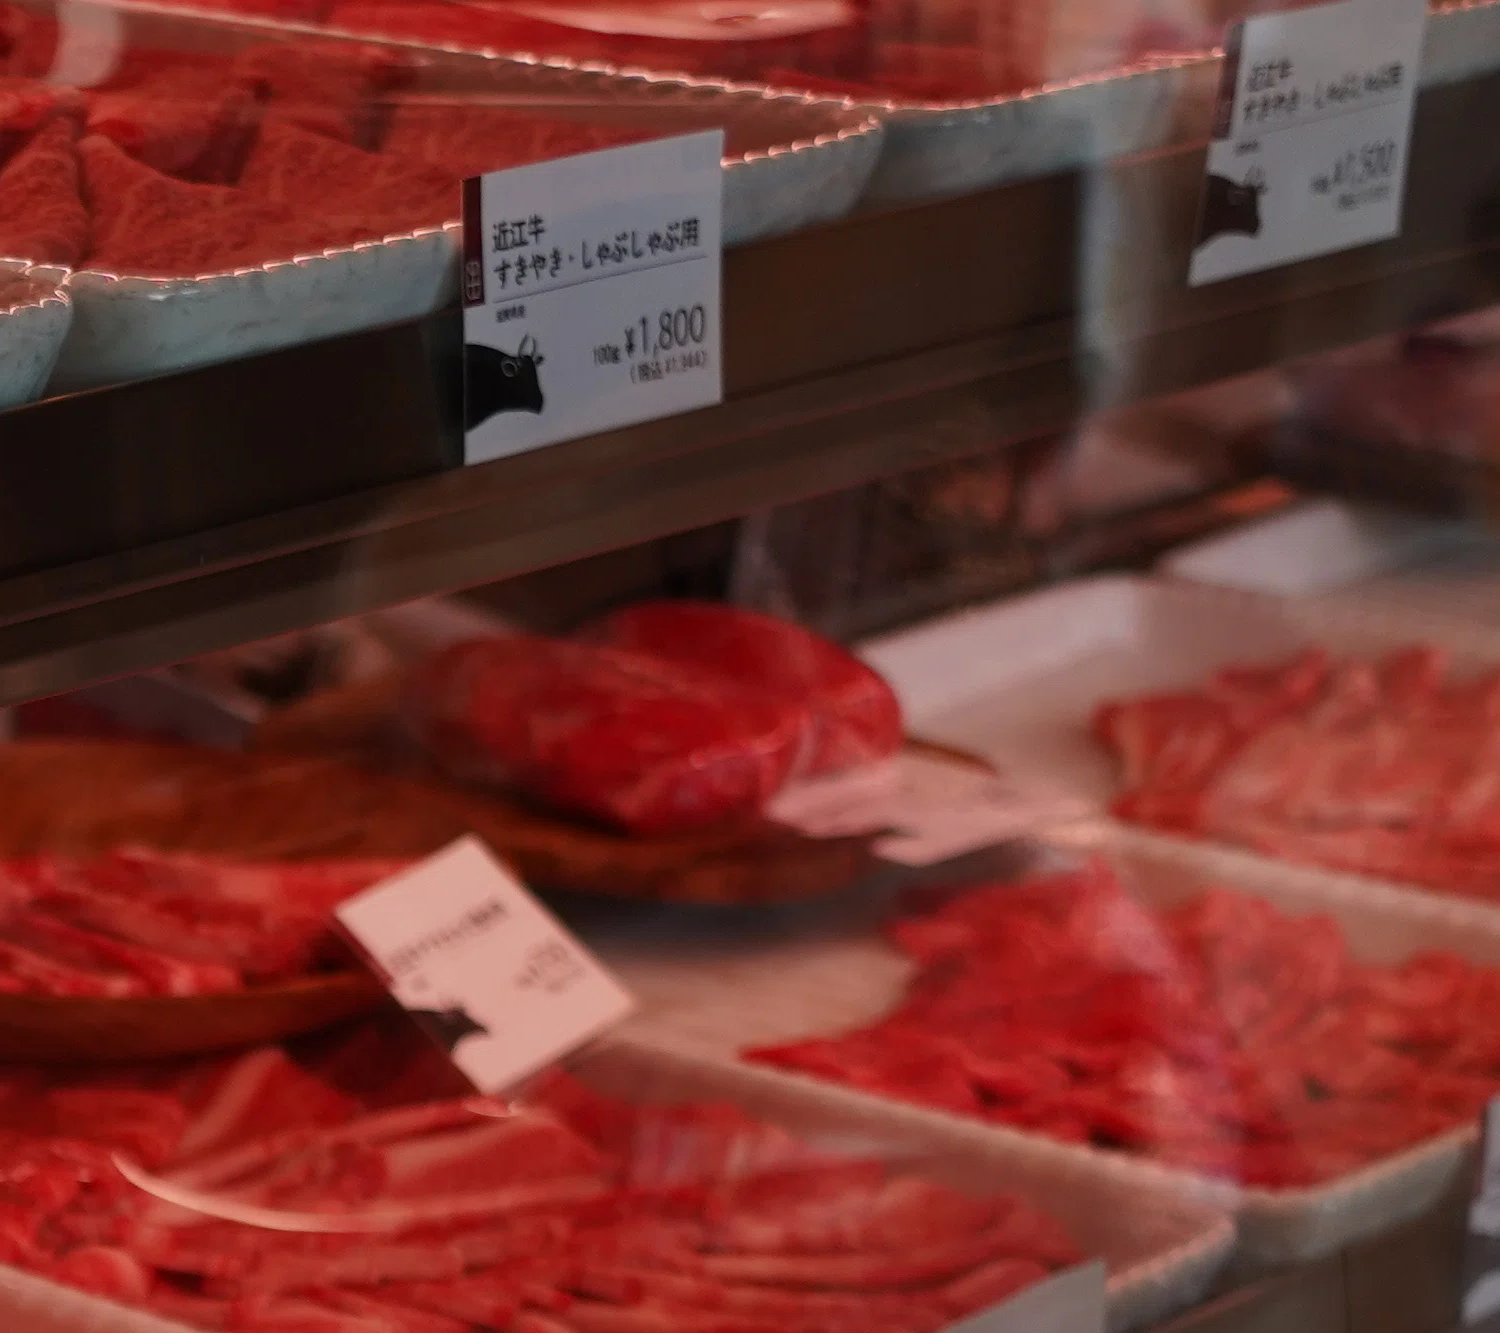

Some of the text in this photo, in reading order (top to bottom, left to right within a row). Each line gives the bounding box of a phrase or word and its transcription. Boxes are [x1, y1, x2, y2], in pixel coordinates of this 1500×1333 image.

[491, 213, 545, 253] 近江牛
[493, 217, 700, 289] すきやき・しゃぶしゃぶ用
[625, 305, 706, 359] ¥1,800
